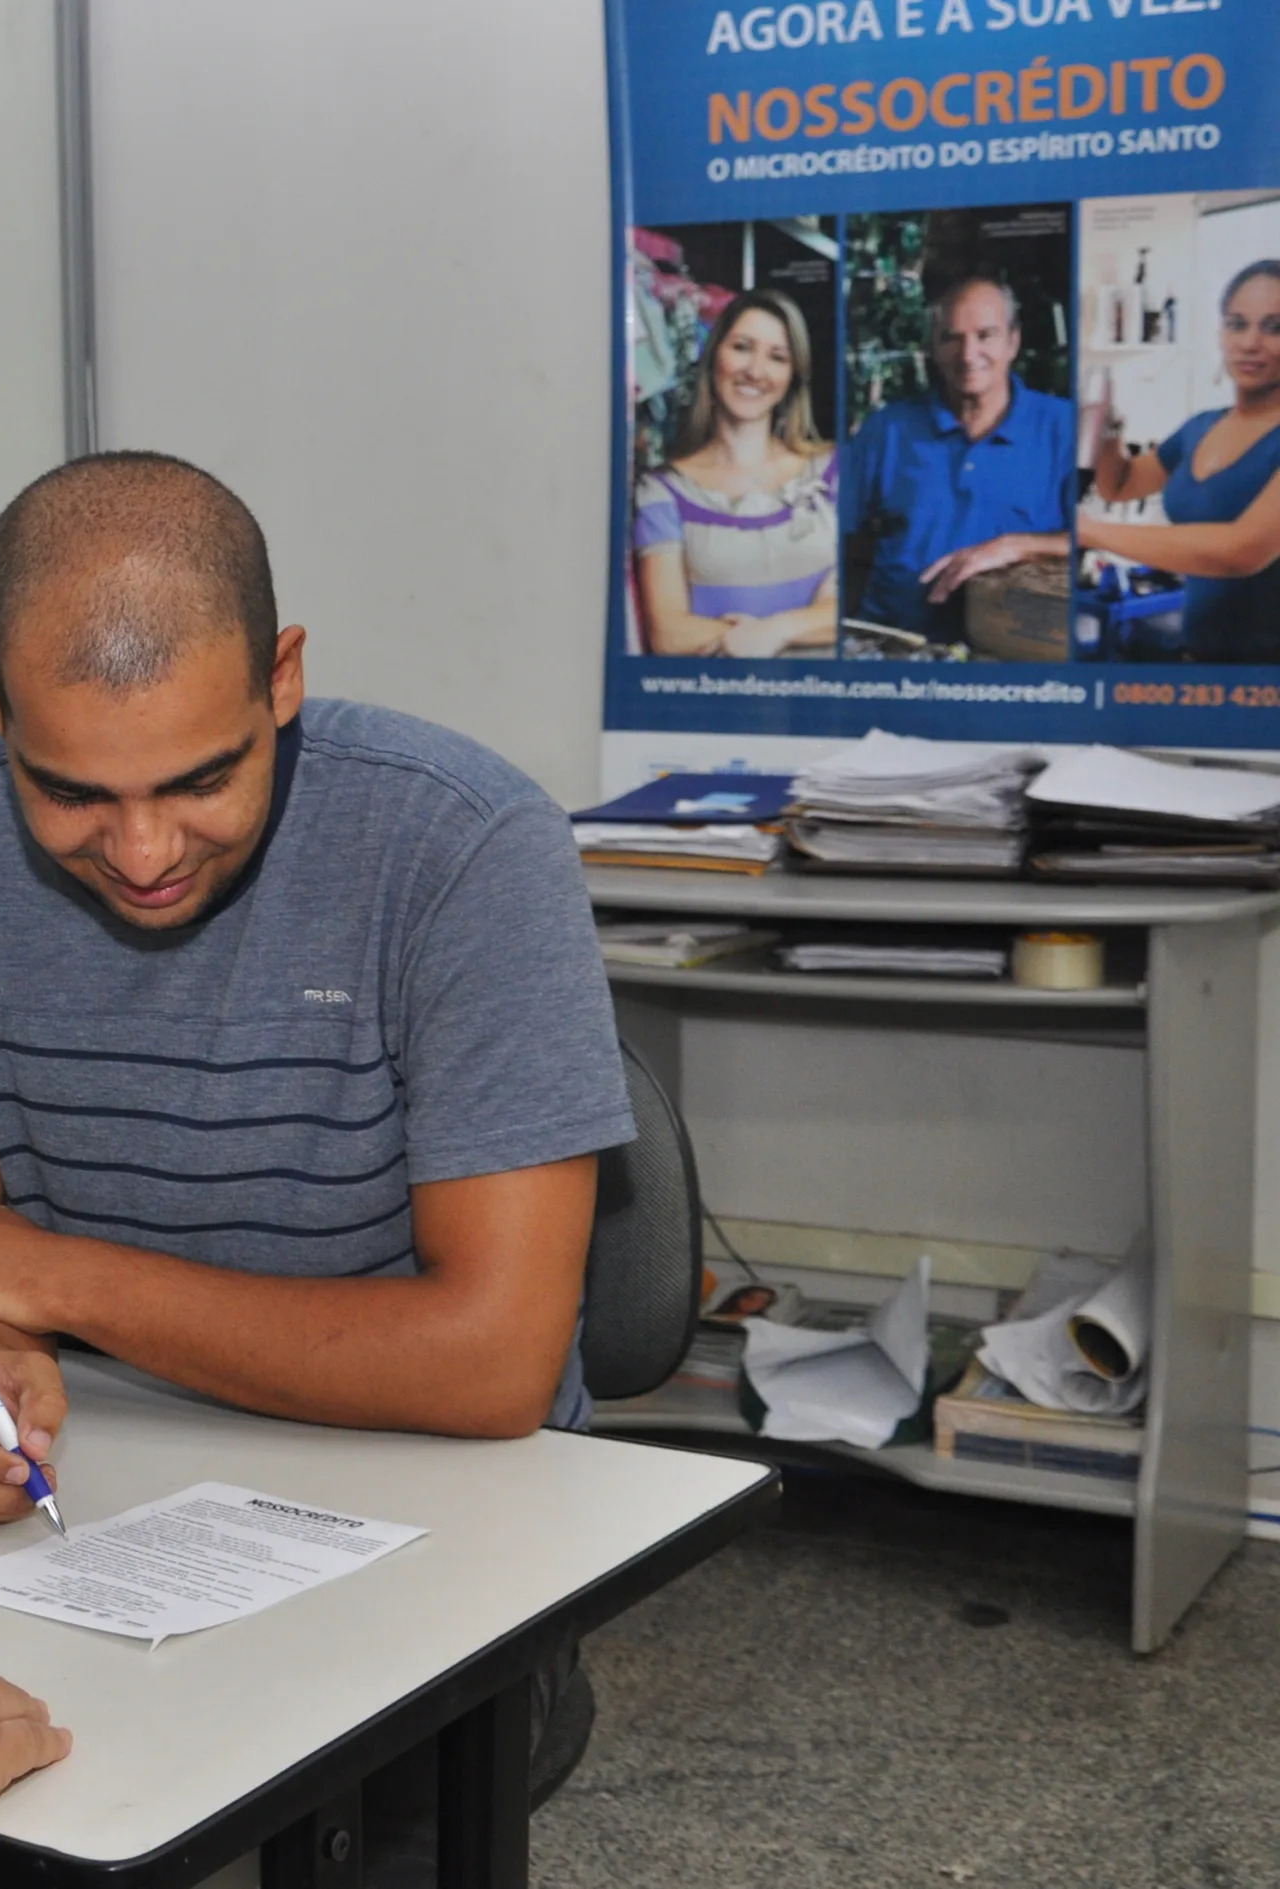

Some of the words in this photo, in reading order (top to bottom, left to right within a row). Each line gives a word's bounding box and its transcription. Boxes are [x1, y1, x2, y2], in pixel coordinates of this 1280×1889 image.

[705, 0, 884, 56] AGORA
[707, 53, 1226, 146] NOSSOCRÉDITO
[706, 156, 732, 183] O
[733, 143, 936, 181] MICROCRÉDITO
[938, 140, 984, 168] DO
[986, 129, 1114, 165] ESPÍRITO
[1117, 123, 1221, 156] SANTO
